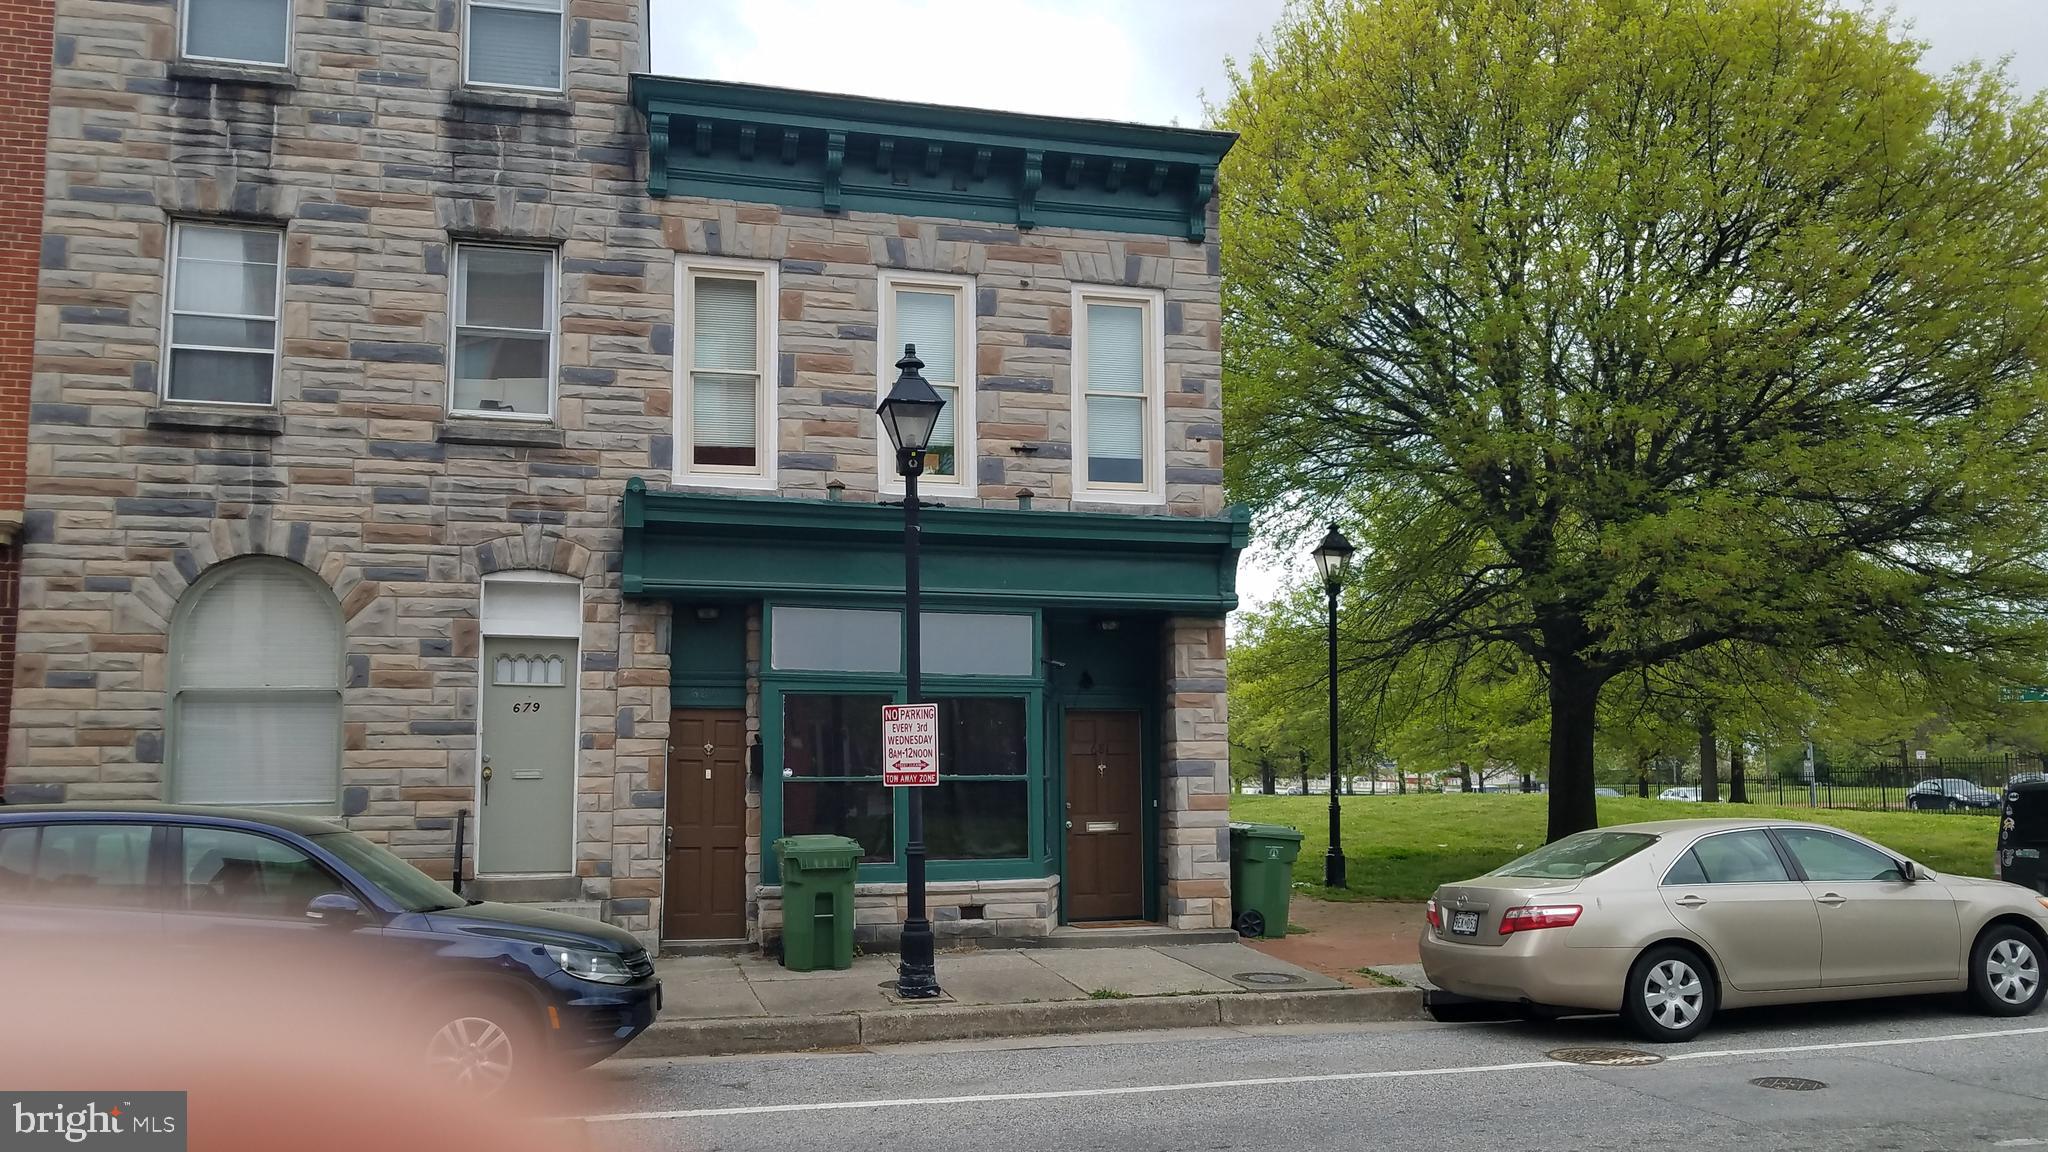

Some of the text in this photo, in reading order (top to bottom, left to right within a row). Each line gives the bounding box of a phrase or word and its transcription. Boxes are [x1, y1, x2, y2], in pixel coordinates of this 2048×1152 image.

[512, 702, 541, 713] 679
[885, 709, 934, 720] NO PARKING
[892, 722, 928, 733] EVERY 3rd
[887, 735, 933, 745] WEDNESDAY
[886, 774, 936, 783] TOW AWAY ZONE
